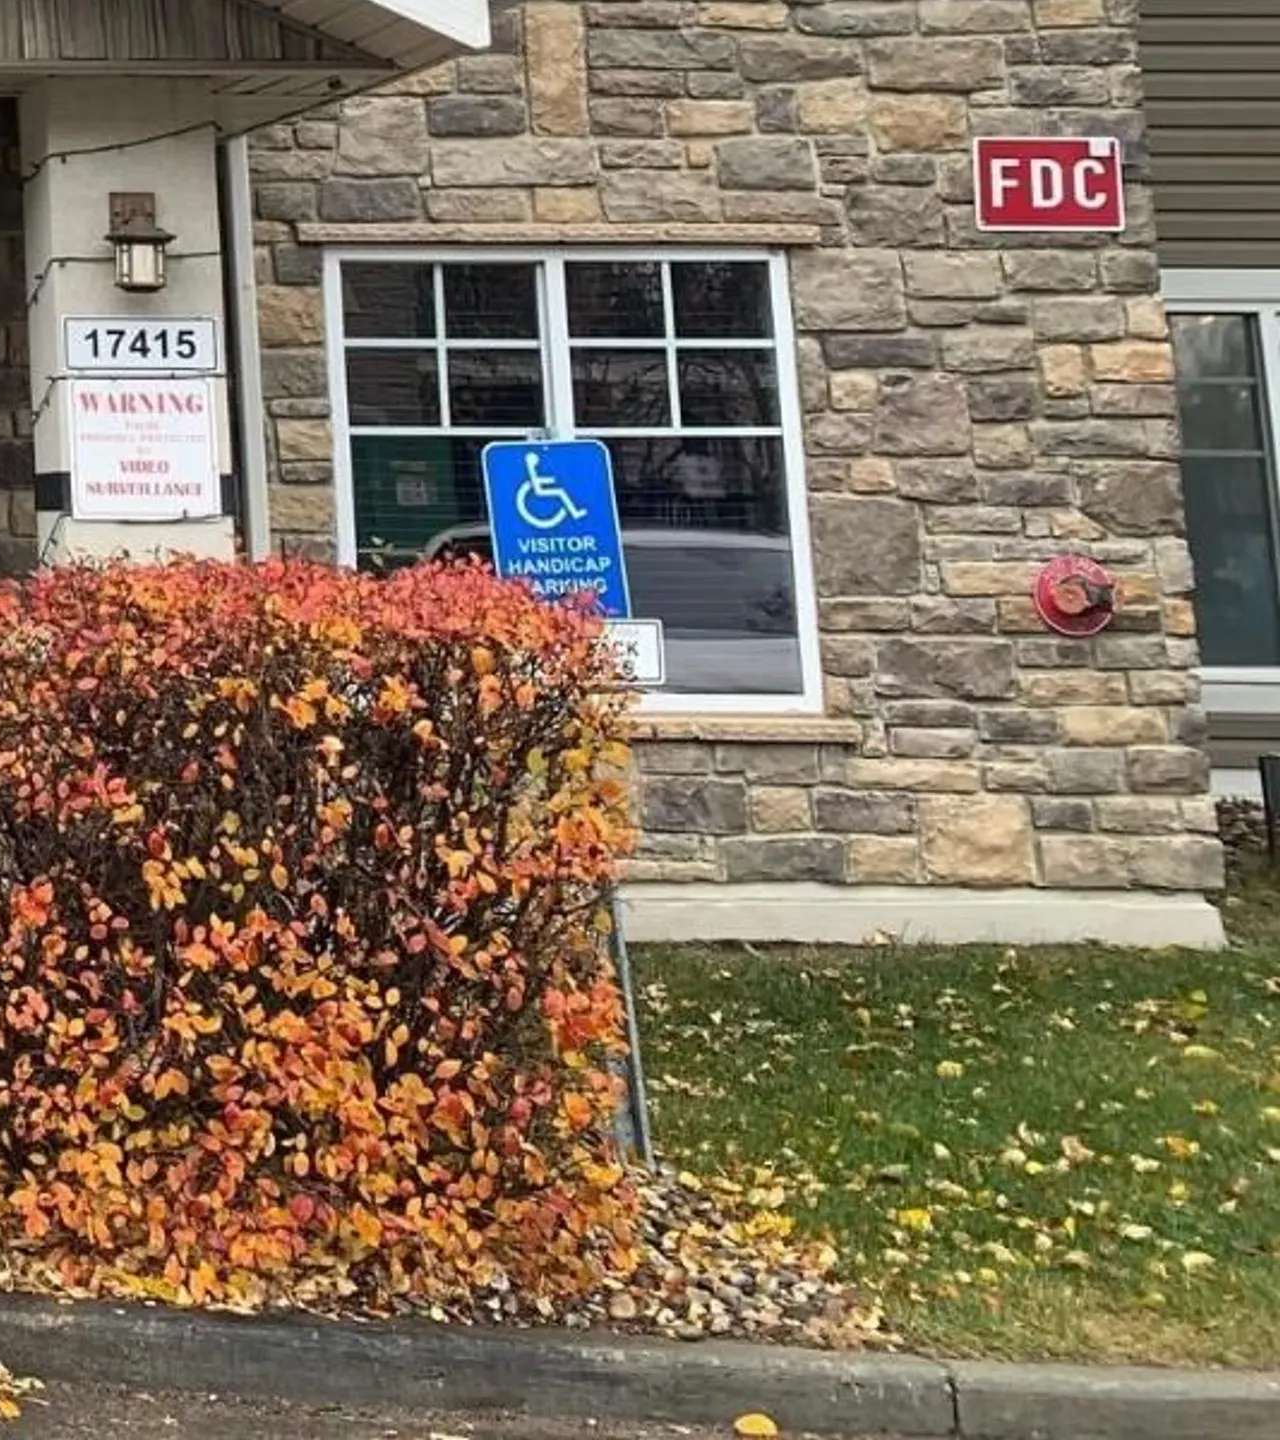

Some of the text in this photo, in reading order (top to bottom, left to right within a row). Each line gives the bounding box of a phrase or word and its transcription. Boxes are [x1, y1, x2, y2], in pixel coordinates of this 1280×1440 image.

[991, 158, 1108, 209] FDC
[84, 328, 197, 359] 17415
[78, 392, 204, 415] WARNING
[516, 535, 597, 554] VISITOR
[507, 556, 612, 575] HANDICAP
